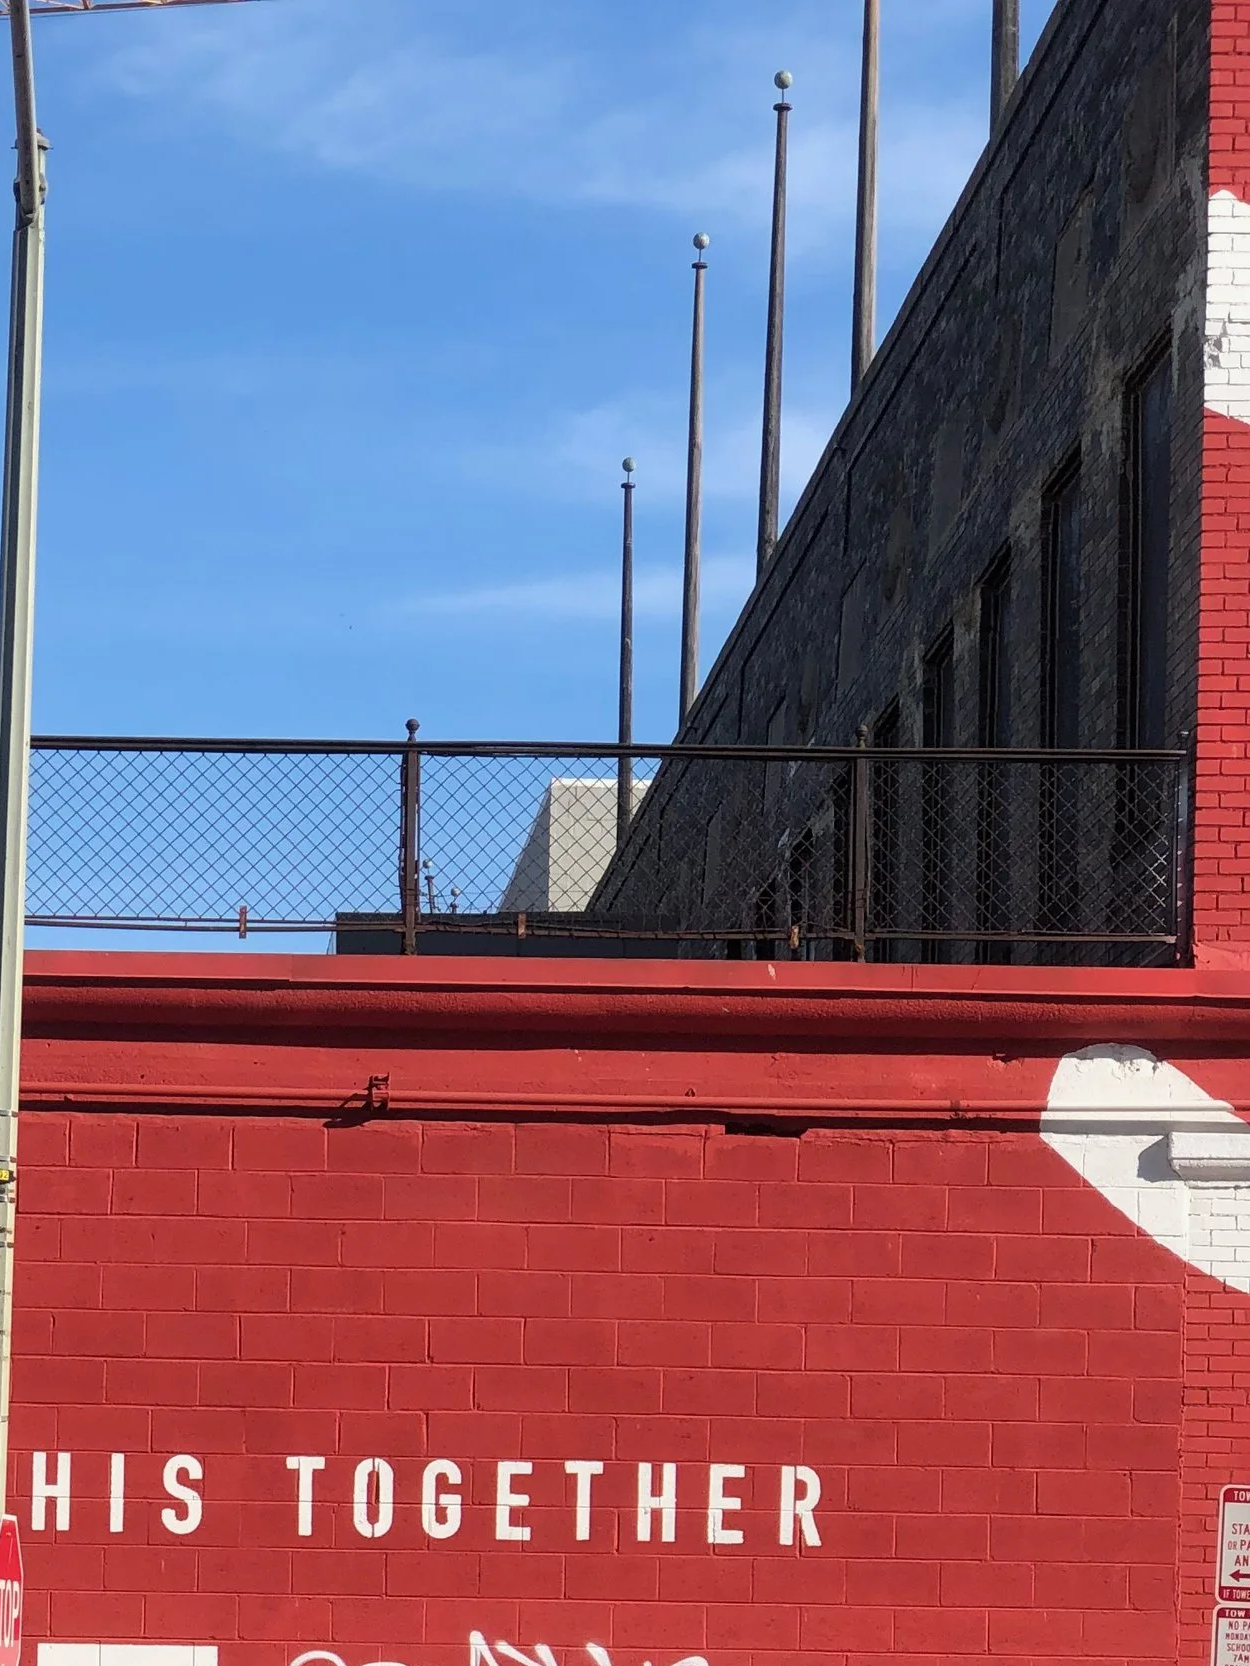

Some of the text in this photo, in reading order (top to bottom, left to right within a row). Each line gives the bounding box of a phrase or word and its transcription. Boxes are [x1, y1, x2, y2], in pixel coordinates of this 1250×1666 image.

[31, 1451, 204, 1535] HIS
[286, 1456, 823, 1547] TOGETHER
[1225, 1609, 1246, 1618] TOW
[1228, 1621, 1239, 1631] NO
